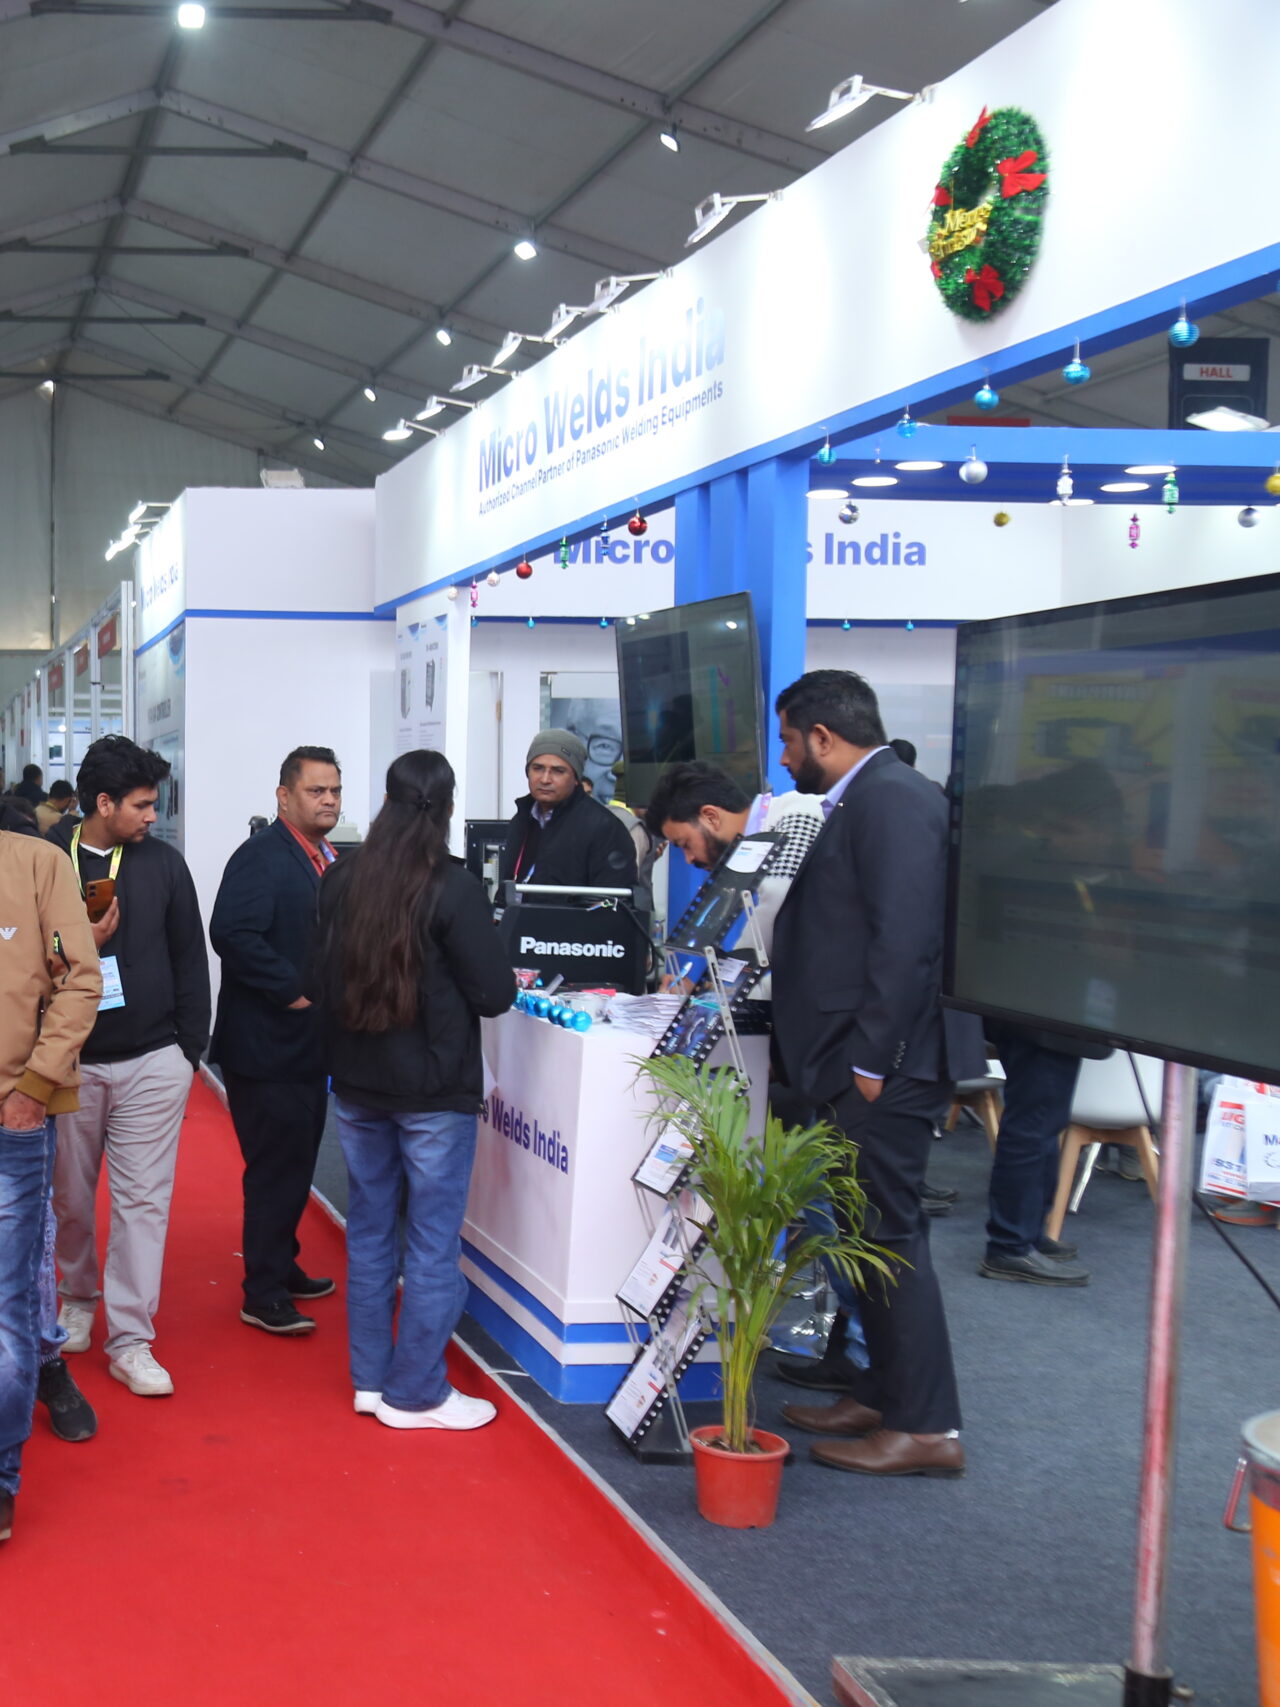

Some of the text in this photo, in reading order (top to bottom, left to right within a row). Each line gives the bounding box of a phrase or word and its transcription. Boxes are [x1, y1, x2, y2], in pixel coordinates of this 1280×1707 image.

[480, 297, 725, 492] Micro Welds India
[1200, 367, 1233, 379] HALL
[479, 487, 511, 515] Authorized
[512, 474, 538, 500] Channel
[538, 461, 565, 484] Partner
[576, 434, 619, 468] Panasonic
[622, 415, 658, 444] Welding
[662, 379, 723, 427] Equipments
[824, 532, 927, 566] India
[520, 936, 625, 958] Panasonic
[491, 1094, 531, 1150] Welds
[533, 1119, 569, 1175] India
